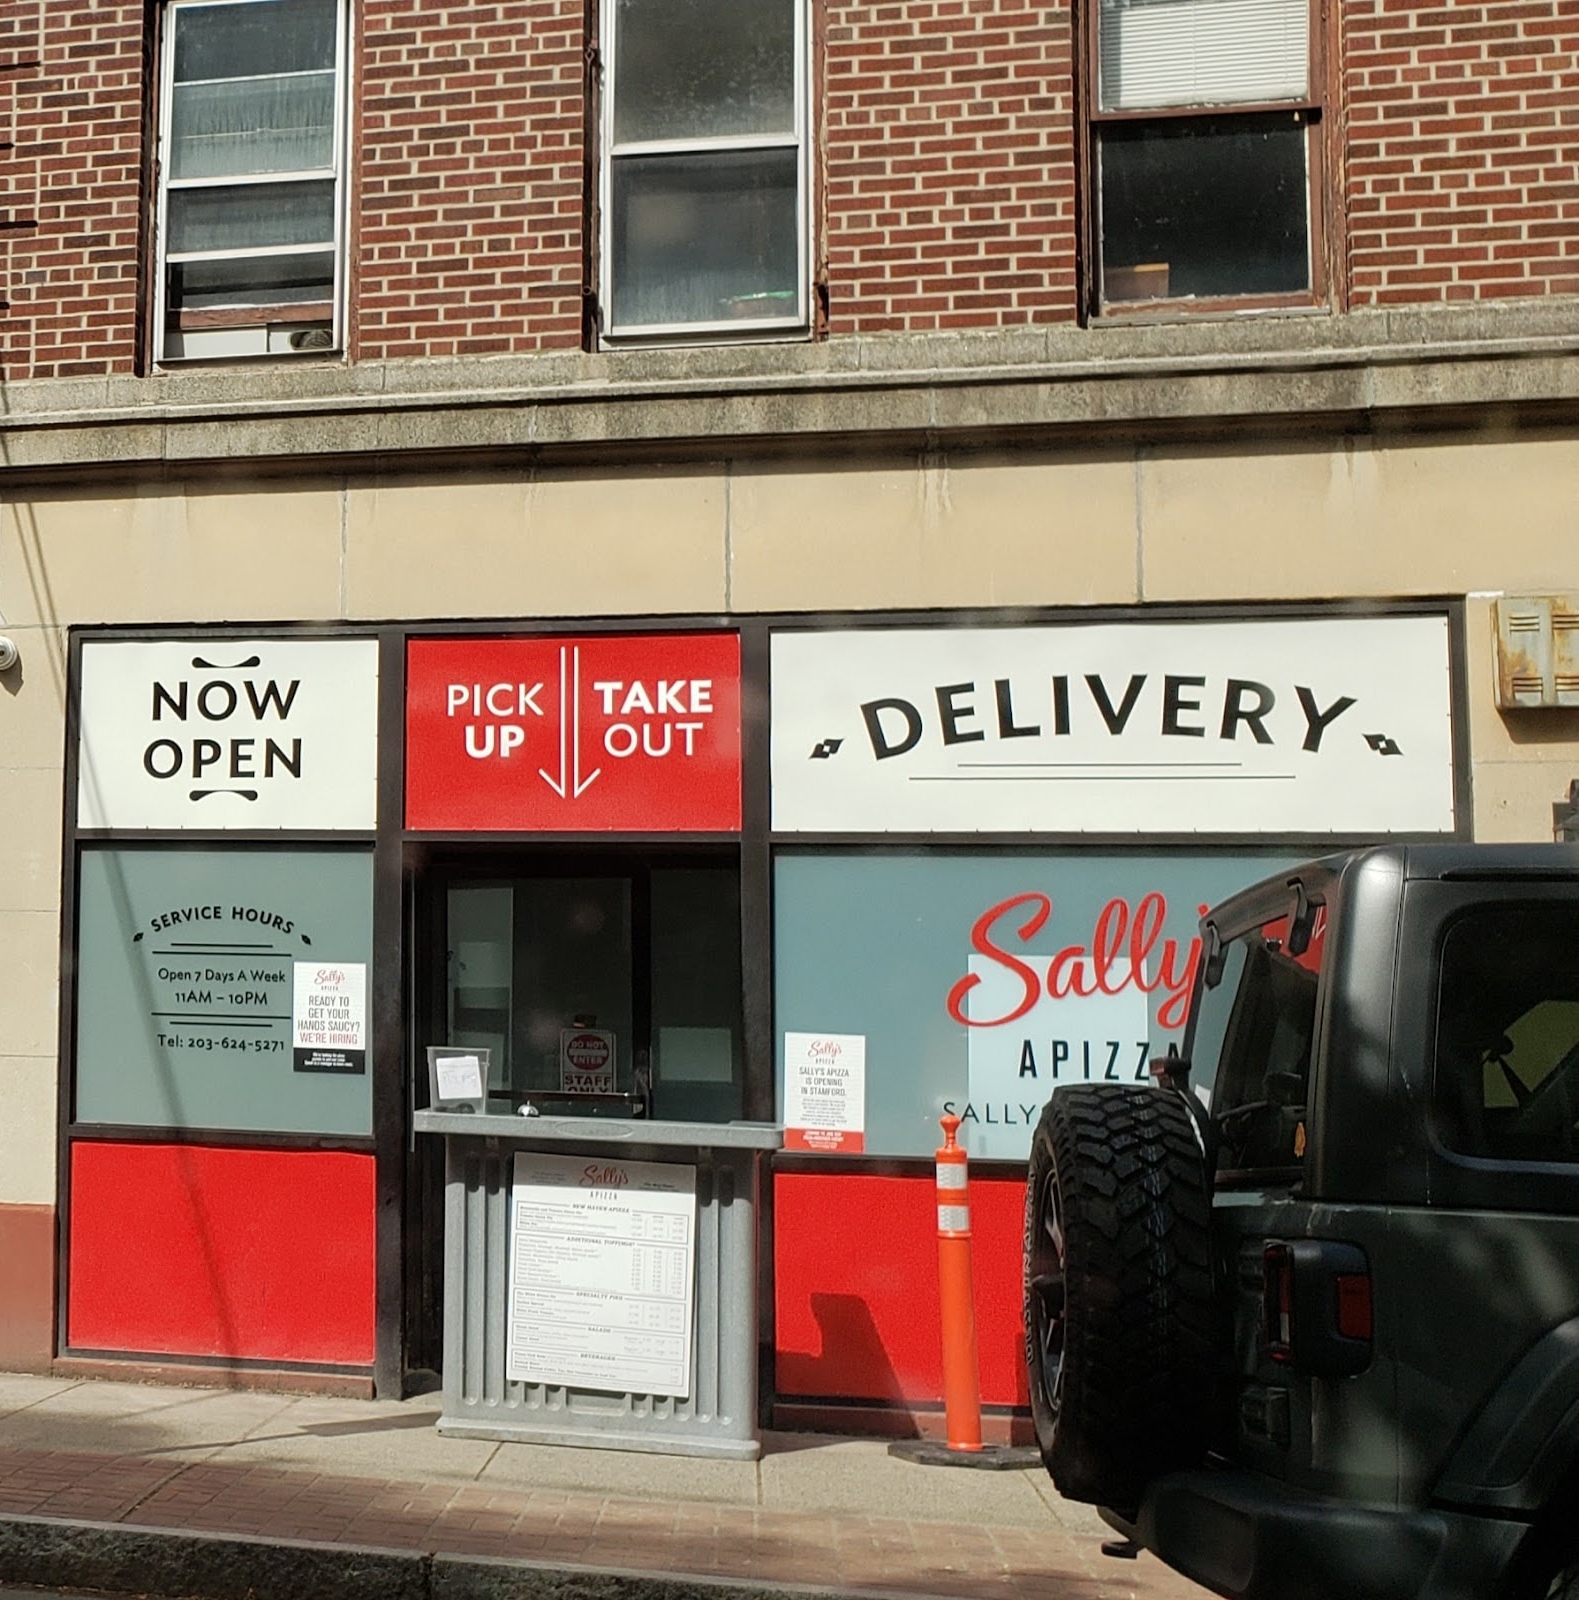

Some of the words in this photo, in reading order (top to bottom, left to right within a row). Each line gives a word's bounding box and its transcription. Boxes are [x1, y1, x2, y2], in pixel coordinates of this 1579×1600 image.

[152, 678, 301, 722] NOW
[447, 682, 545, 718] PICK
[593, 679, 714, 715] TAKE
[860, 673, 1358, 761] DELIVERY
[464, 724, 526, 759] UP
[603, 721, 704, 758] OUT
[143, 737, 302, 780] OPEN
[150, 906, 222, 932] SERVICE
[232, 906, 294, 934] HOURS
[946, 891, 1210, 1029] Sally'
[158, 968, 191, 983] Open
[195, 971, 201, 982] 7
[205, 969, 234, 984] Days
[237, 970, 247, 981] A
[250, 970, 285, 982] Week
[175, 990, 212, 1004] 11AM
[229, 991, 268, 1005] 10PM
[308, 995, 336, 1007] READY
[338, 996, 350, 1008] TO
[297, 1019, 326, 1031] HANDS
[328, 1021, 360, 1033] SAUCY?
[308, 1007, 325, 1019] GET
[327, 1008, 350, 1020] YOUR
[157, 1034, 183, 1048] Tel:
[188, 1037, 285, 1052] 203-624-5271
[300, 1032, 327, 1044] WE'RE
[329, 1033, 358, 1045] HIRING
[565, 1075, 611, 1086] STAFF
[579, 1164, 629, 1189] Sally's
